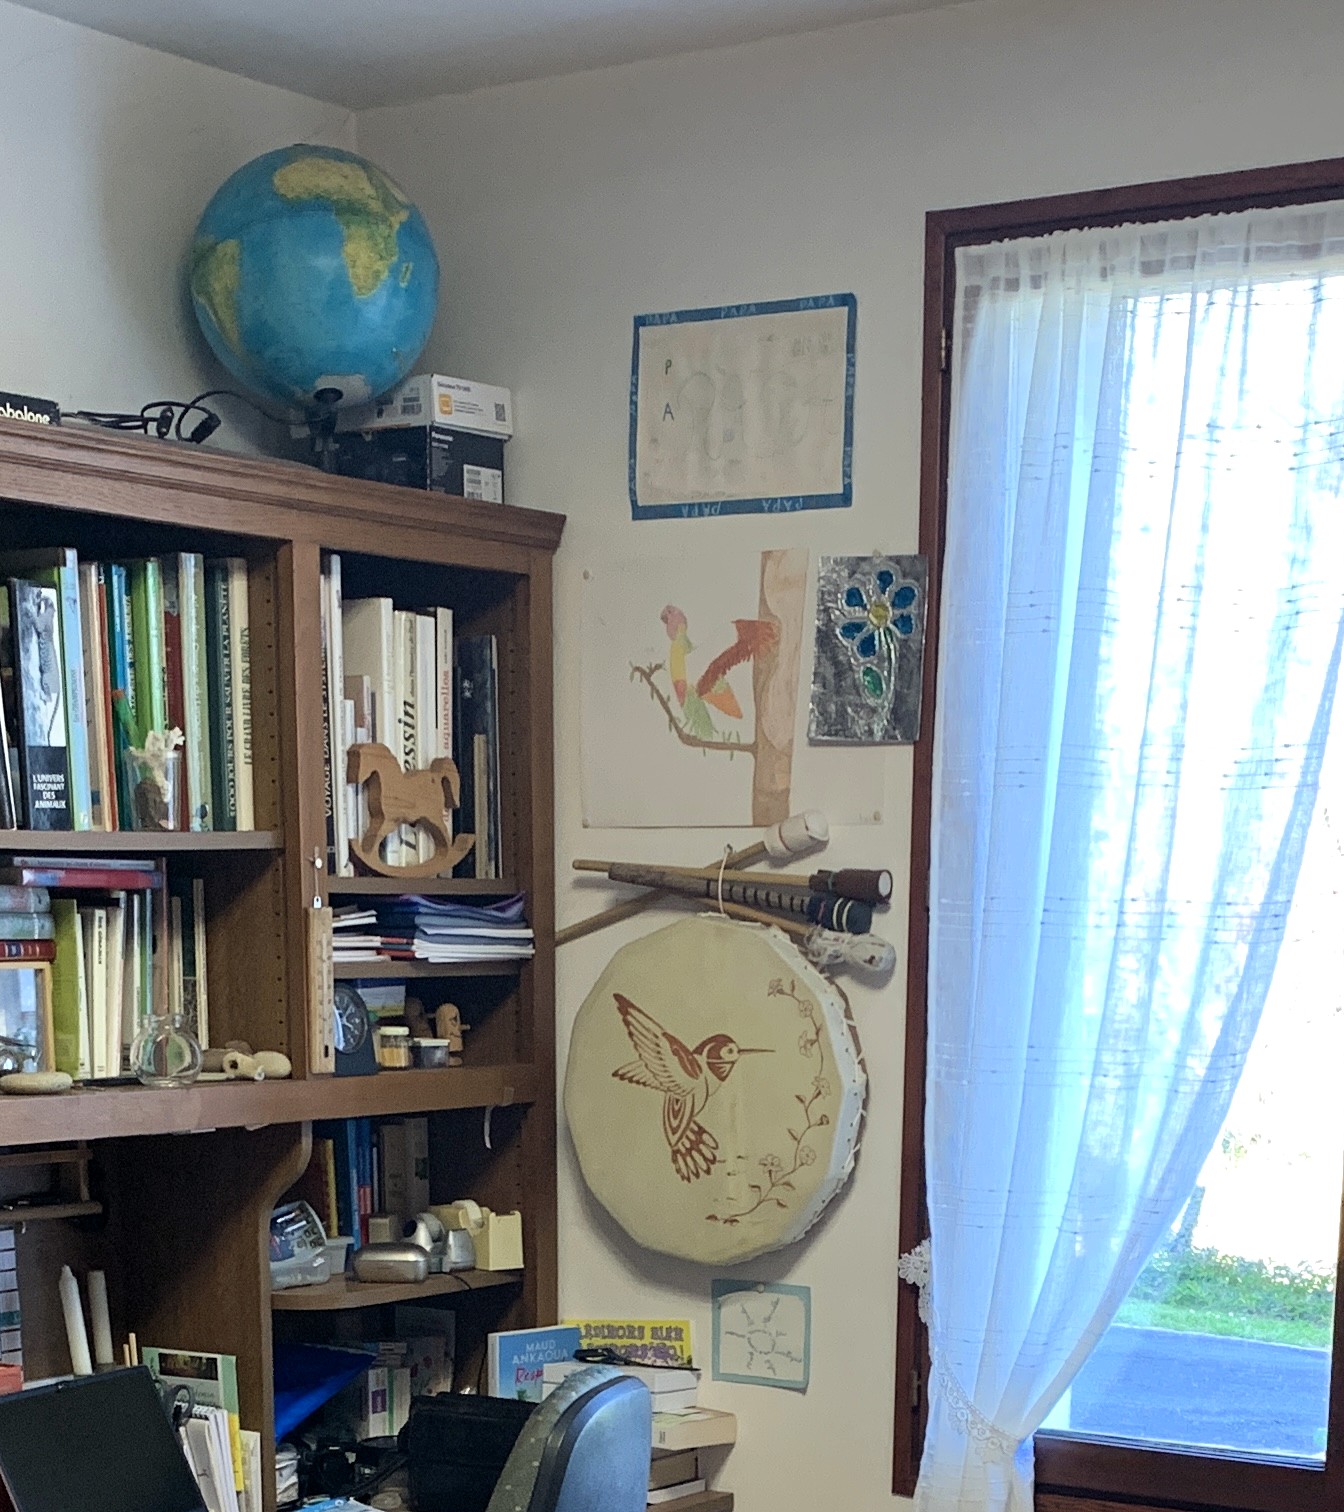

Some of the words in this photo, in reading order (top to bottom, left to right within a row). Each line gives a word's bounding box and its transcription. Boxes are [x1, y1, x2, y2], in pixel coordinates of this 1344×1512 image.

[720, 304, 756, 319] PAPA
[665, 359, 673, 375] P
[663, 402, 675, 422] A
[223, 656, 232, 704] SAUVER
[242, 688, 251, 717] LIVRE
[440, 670, 453, 750] aquarelles
[225, 706, 234, 741] POUR
[243, 718, 253, 751] GRAND
[398, 700, 416, 772] essin
[226, 744, 235, 780] JOURS
[34, 800, 66, 810] ANIMAUX
[42, 791, 56, 800] DES
[323, 763, 333, 818] VOYAGE
[525, 1340, 557, 1351] MAUD
[515, 1367, 544, 1384] Resp
